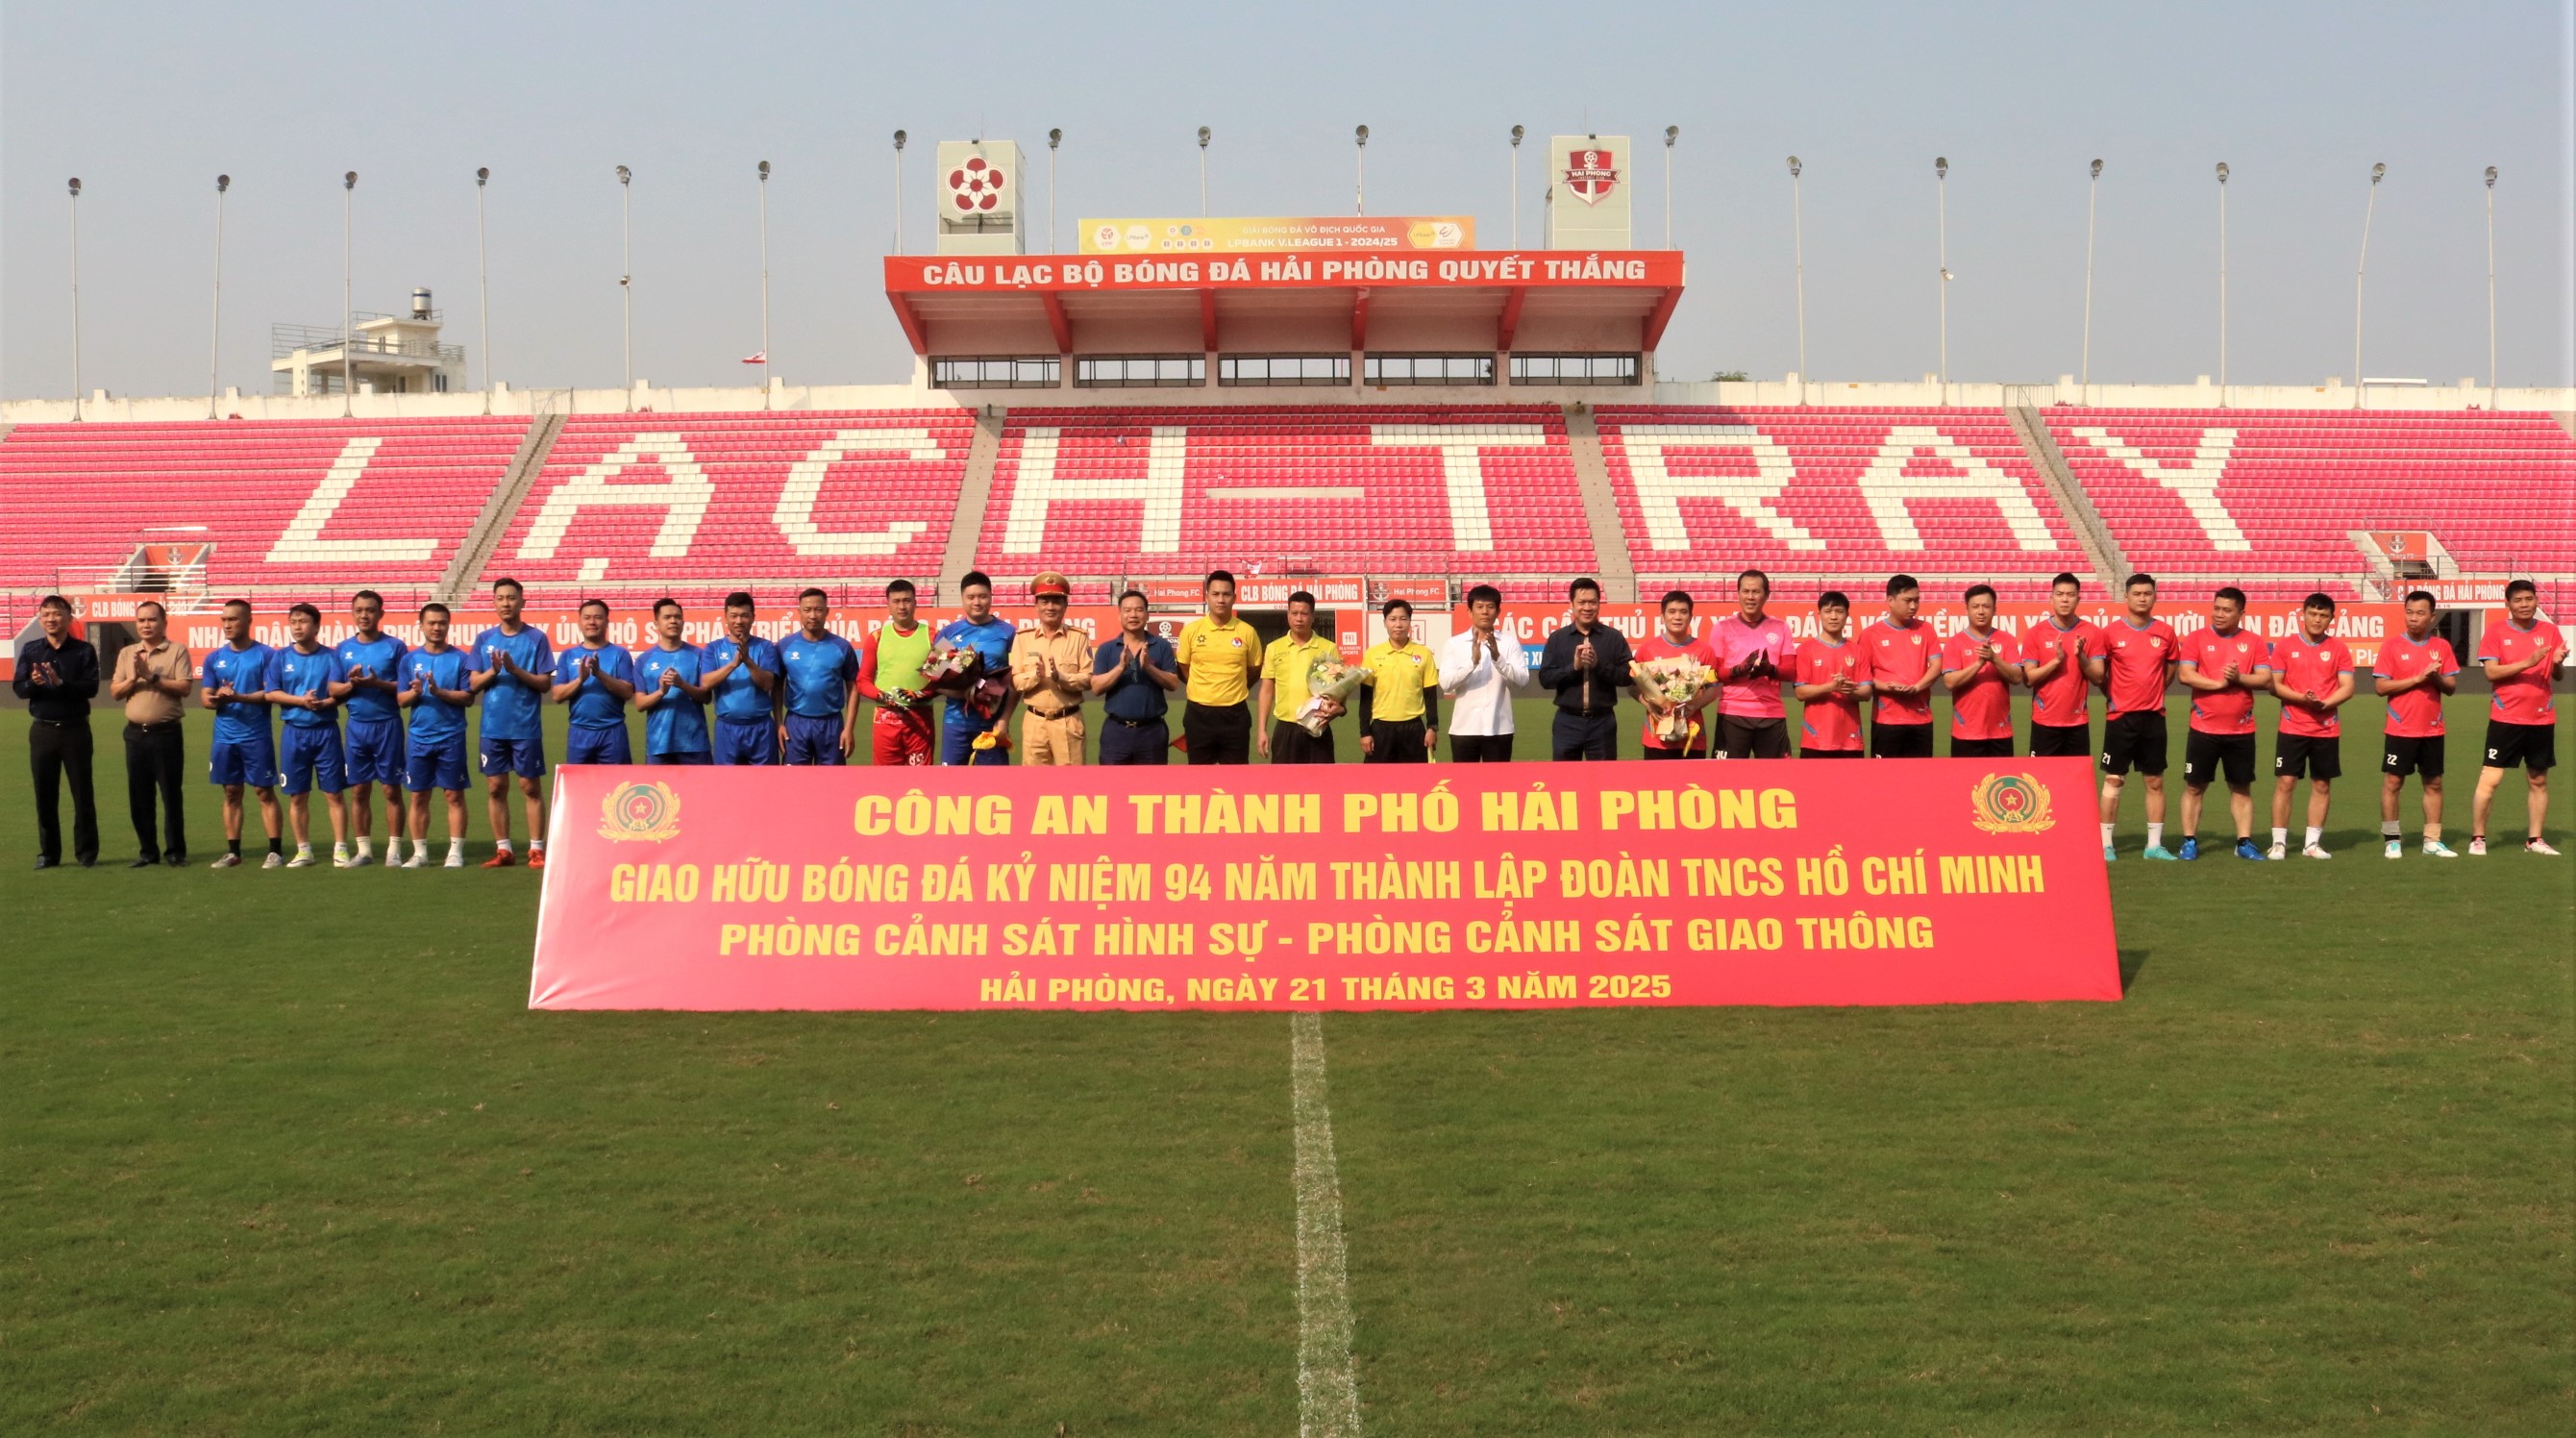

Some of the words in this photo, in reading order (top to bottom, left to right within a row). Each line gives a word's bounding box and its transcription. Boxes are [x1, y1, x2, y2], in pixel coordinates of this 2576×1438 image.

[1227, 238, 1276, 247] LPBANK
[1277, 237, 1334, 247] V.LEAGUE
[1336, 237, 1343, 246] 1
[1351, 237, 1399, 247] 2024/25
[924, 261, 984, 285] CÂU
[996, 264, 1053, 288] LẠC
[1063, 260, 1103, 287] BỘ
[1114, 259, 1199, 284] BÓNG
[1208, 258, 1251, 282] ĐÁ
[1261, 255, 1312, 281] HẢI
[1323, 256, 1428, 281] PHÒNG
[1439, 255, 1535, 281] QUYẾT
[1545, 254, 1646, 280] THẮNG
[1167, 588, 1189, 598] Phong
[1241, 585, 1259, 602] CLB
[1262, 582, 1288, 601] BÓNG
[1325, 581, 1357, 601] PHÒNG
[2443, 582, 2456, 601] ĐÁ
[2458, 580, 2473, 601] HẢI
[2476, 581, 2506, 600] PHÒNG
[92, 602, 109, 617] CLB
[111, 598, 136, 617] BÓNG
[607, 617, 638, 650] HỘ
[681, 616, 728, 644] PHÁ
[1654, 615, 1702, 638] HY
[2268, 607, 2305, 637] ĐẤ
[2102, 753, 2111, 765] 21
[2387, 754, 2397, 766] 22
[2488, 748, 2498, 759] 12
[855, 788, 1012, 836] CÔNG
[1030, 795, 1107, 834] AN
[1128, 788, 1320, 834] THÀNH
[1344, 780, 1459, 832] PHỐ
[1481, 781, 1578, 831] HẢI
[1600, 783, 1796, 830] PHÒNG
[610, 863, 701, 903] GIAO
[711, 856, 790, 903] HỮU
[802, 856, 909, 903] BÓNG
[921, 855, 973, 902] ĐÁ
[987, 851, 1036, 902] KỶ
[1050, 855, 1151, 909] NIỆM
[1165, 863, 1211, 902] 94
[1226, 855, 1316, 901] NĂM
[1330, 854, 1460, 900] THÀNH
[1474, 853, 1547, 907] LẬP
[1560, 852, 1669, 898] ĐOÀN
[1681, 857, 1784, 896] TNCS
[1796, 845, 1848, 896] HỒ
[1862, 849, 1927, 895] CHÍ
[1940, 855, 2043, 893] MINH
[720, 916, 861, 956] PHÒNG
[875, 913, 988, 955] CẢNH
[1003, 917, 1080, 955] SÁT
[1094, 917, 1193, 955] HÌNH
[1209, 920, 1268, 962] SỰ
[1308, 914, 1450, 954] PHÒNG
[1467, 910, 1580, 953] CẢNH
[1596, 913, 1672, 952] SÁT
[1688, 918, 1782, 951] GIAO
[1796, 911, 1933, 949] THÔNG
[980, 971, 1036, 1002] HẢI
[1049, 973, 1174, 1004] PHÒNG,
[1187, 973, 1277, 1001] NGÀY
[1290, 979, 1325, 1001] 21
[1342, 972, 1453, 1000] THÁNG
[1467, 977, 1485, 1000] 3
[1498, 971, 1576, 999] NĂM
[1590, 975, 1671, 998] 2025
